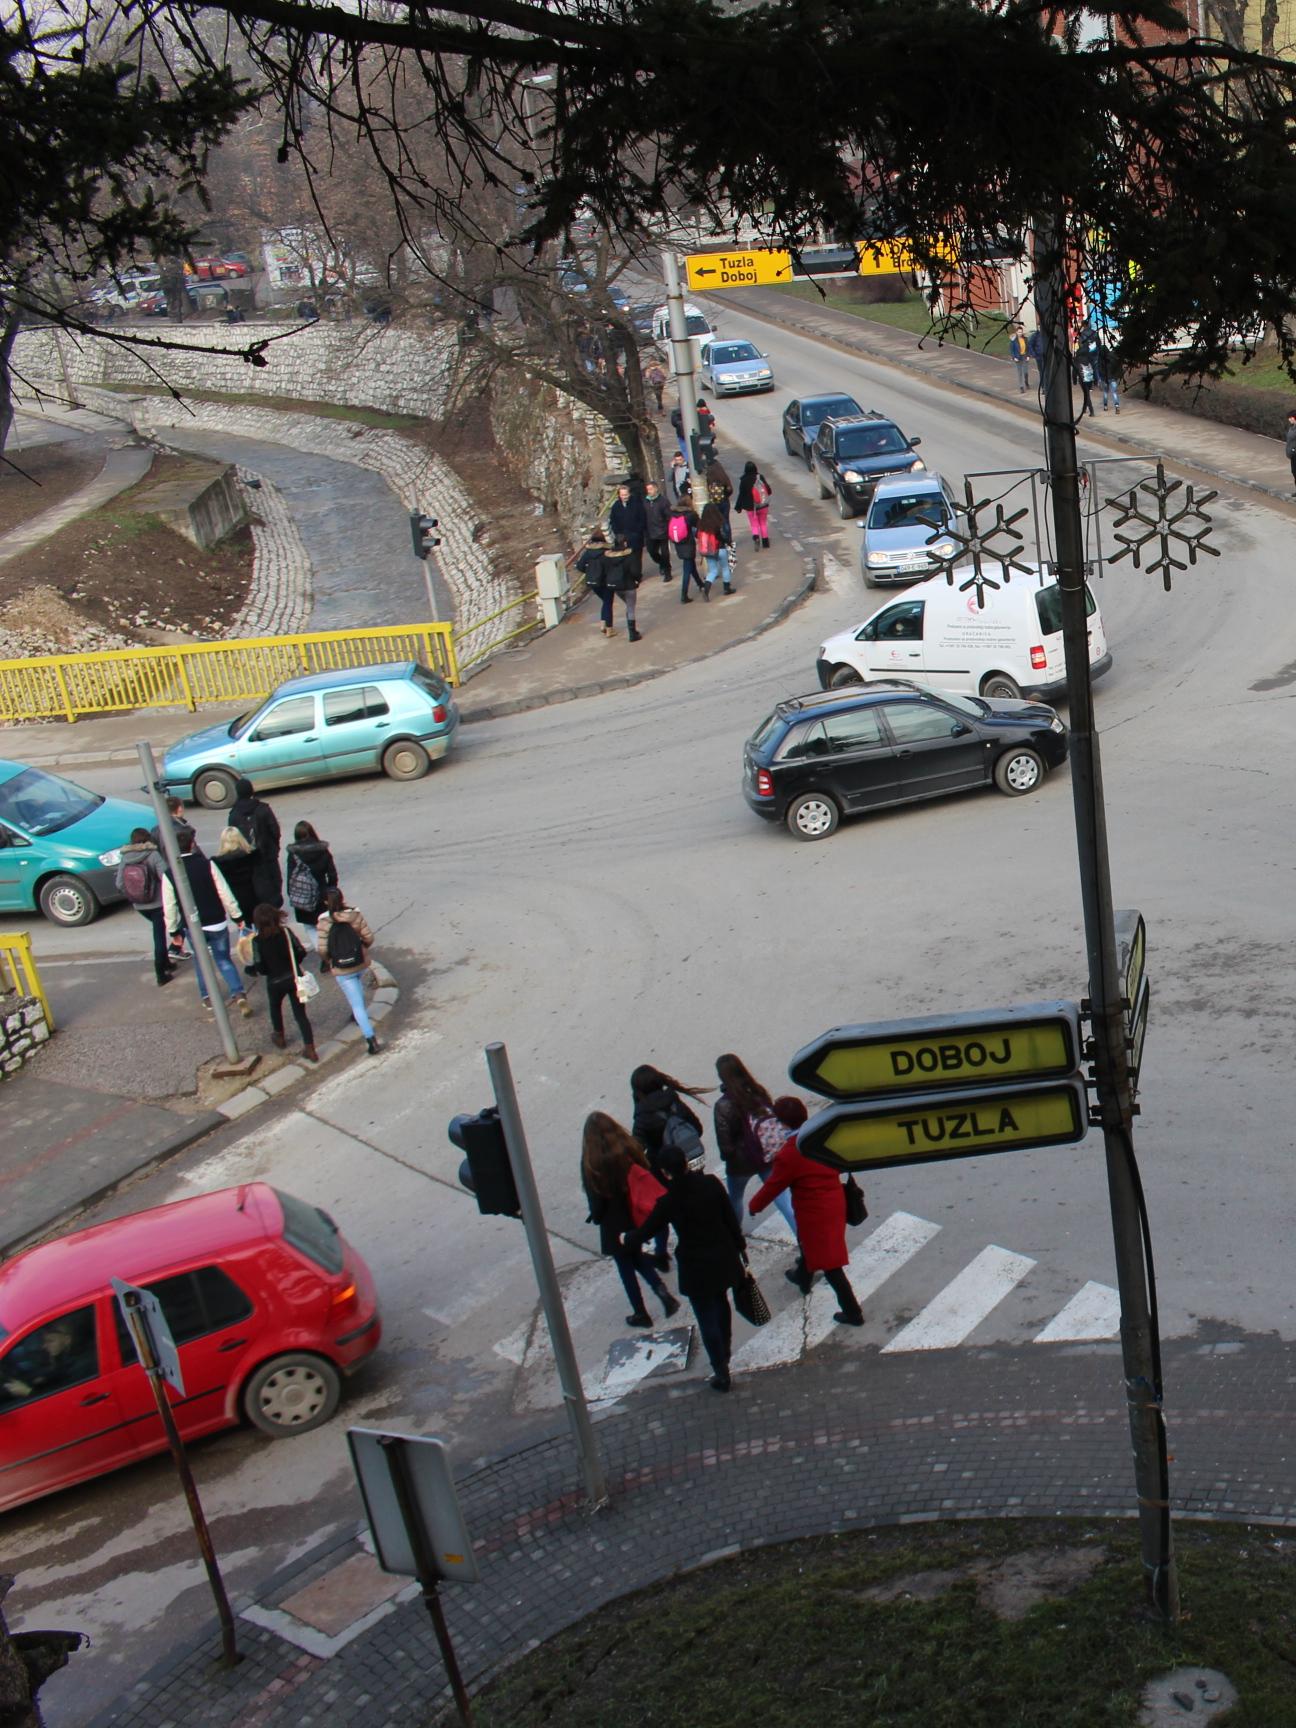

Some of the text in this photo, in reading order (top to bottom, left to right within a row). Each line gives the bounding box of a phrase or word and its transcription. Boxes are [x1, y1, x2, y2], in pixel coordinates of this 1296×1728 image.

[719, 256, 754, 269] Tuzla
[720, 269, 758, 283] Doboj
[890, 1038, 1012, 1076] DOBOJ
[897, 1107, 1020, 1145] TUZLA
